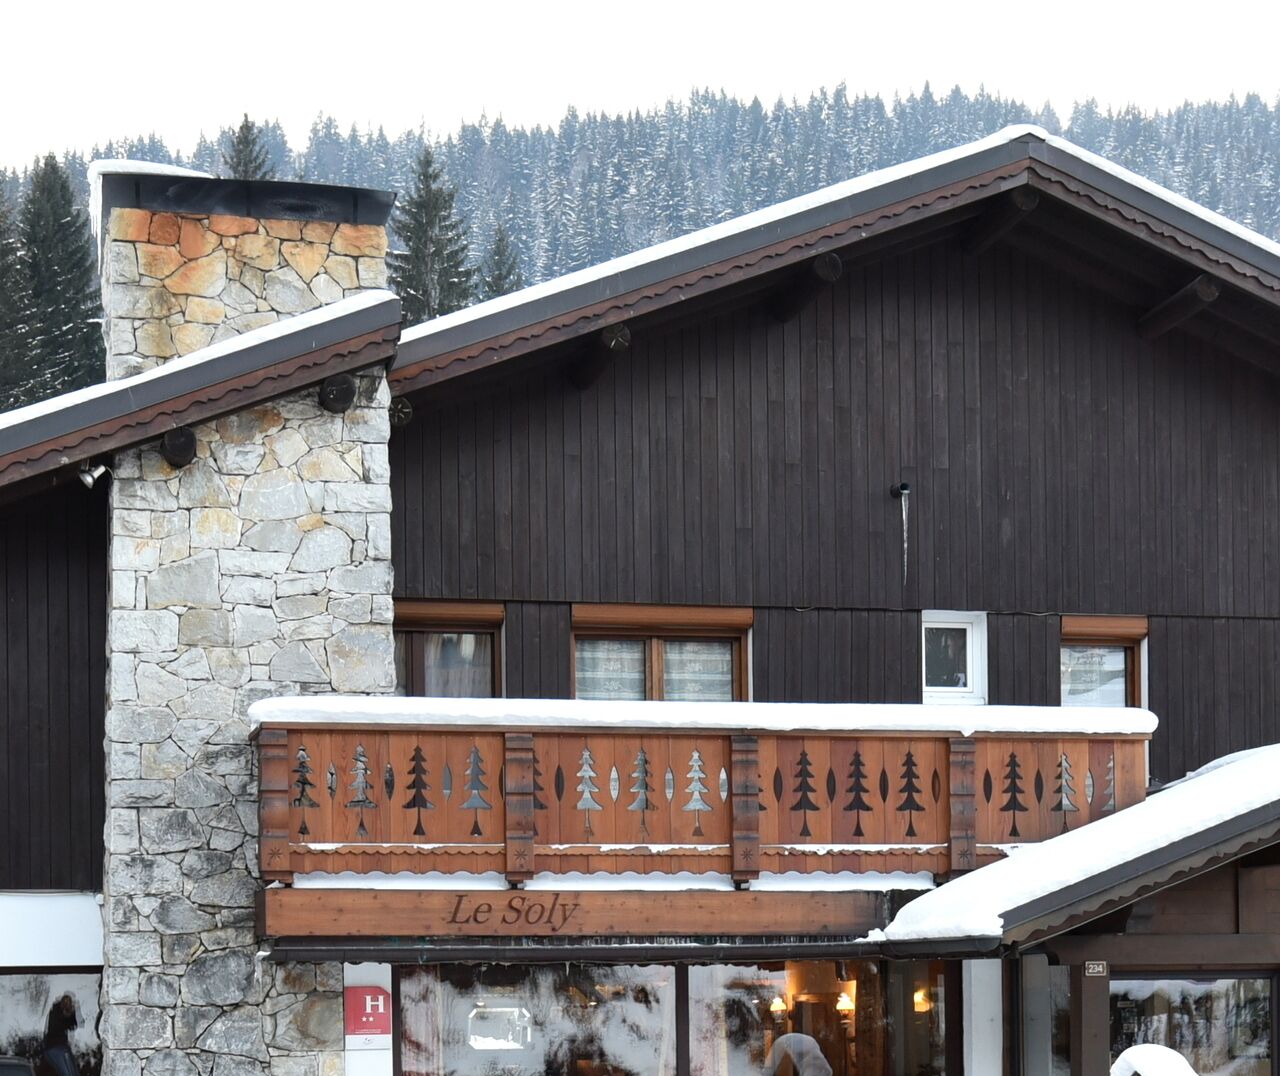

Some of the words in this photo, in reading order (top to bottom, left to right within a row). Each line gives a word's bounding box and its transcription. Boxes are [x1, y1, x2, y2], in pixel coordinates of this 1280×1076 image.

[446, 894, 493, 925] Le
[501, 892, 581, 932] Soly
[1088, 964, 1104, 973] 234
[364, 995, 385, 1014] H
